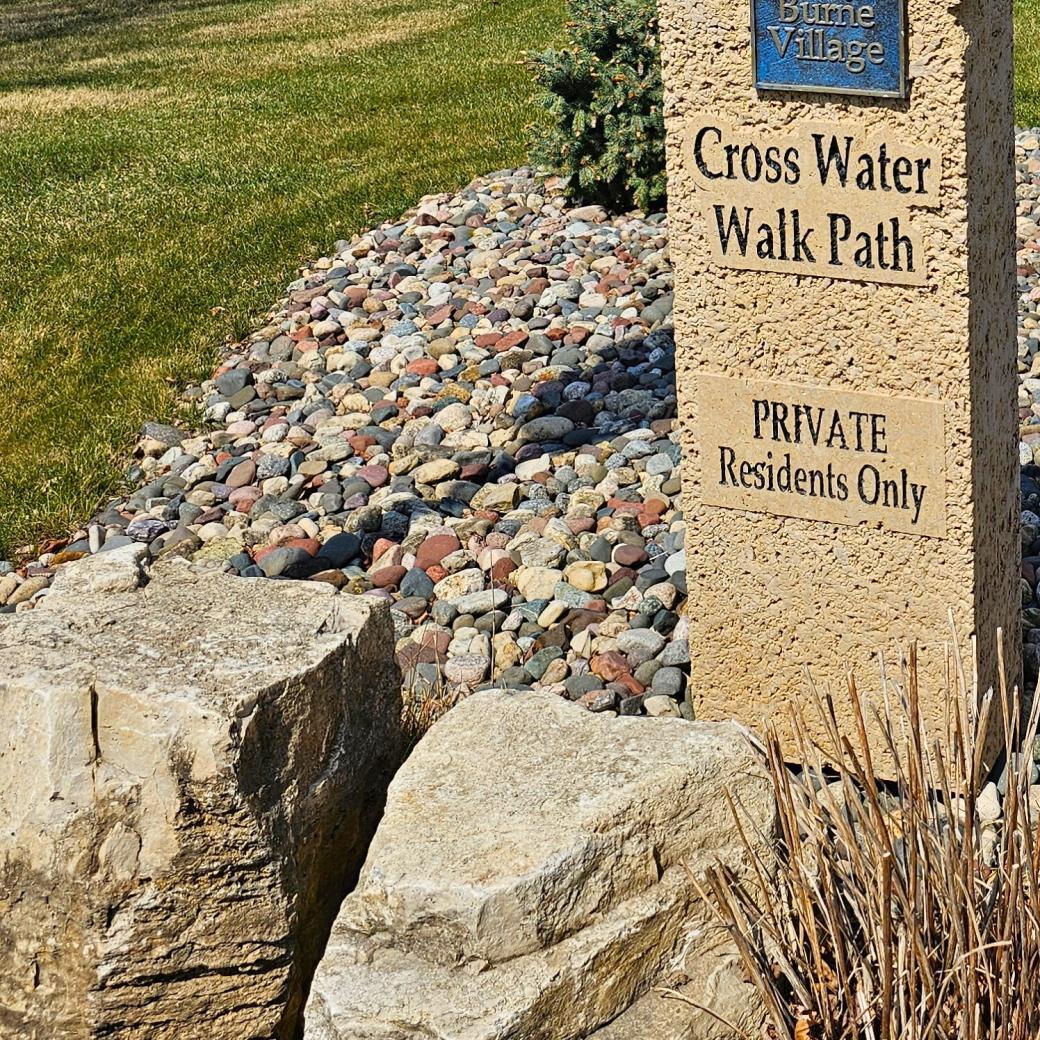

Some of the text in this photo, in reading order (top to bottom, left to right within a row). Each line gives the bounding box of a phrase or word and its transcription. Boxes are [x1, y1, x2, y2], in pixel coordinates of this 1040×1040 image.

[767, 25, 885, 73] Village
[693, 125, 931, 195] Cross Water
[712, 204, 916, 273] Walk Path
[752, 398, 888, 454] PRIVATE
[718, 445, 927, 525] Residents Only
